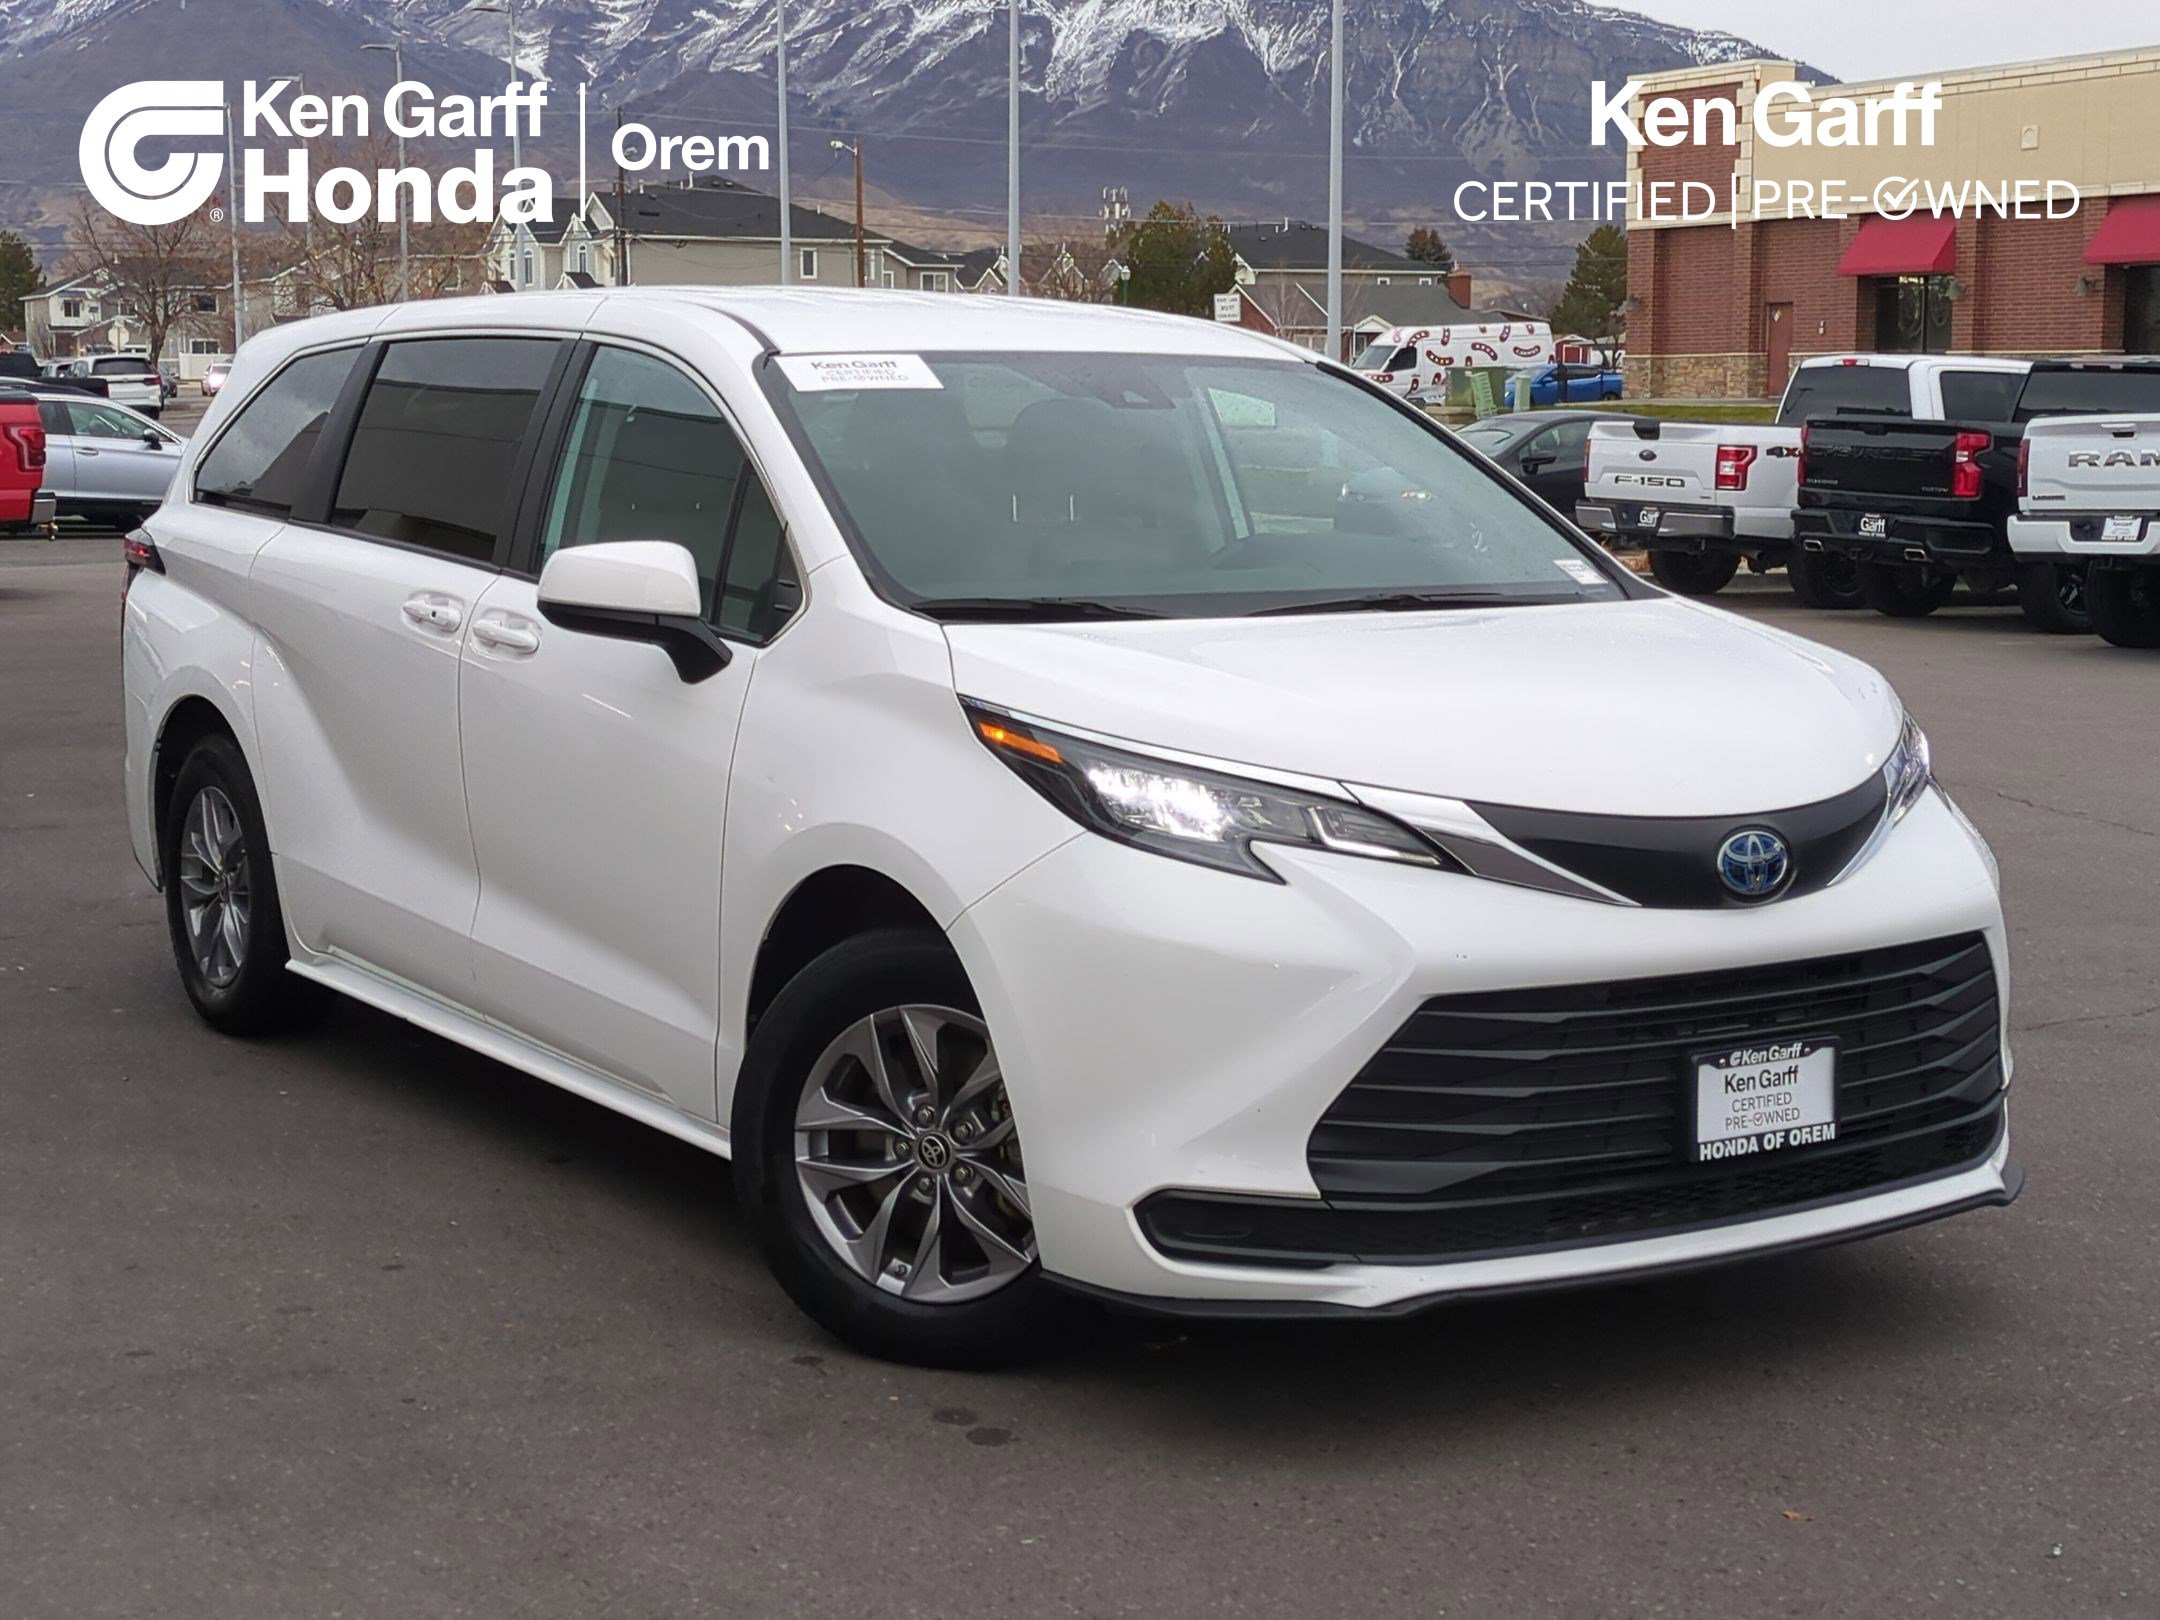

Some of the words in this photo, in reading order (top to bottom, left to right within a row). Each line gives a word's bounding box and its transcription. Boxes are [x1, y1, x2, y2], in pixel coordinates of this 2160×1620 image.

[1614, 475, 1685, 488] F-150
[1741, 1049, 1767, 1066] Ken
[1768, 1042, 1803, 1061] Garff
[1724, 1073, 1757, 1094] Ken
[1759, 1065, 1799, 1089] Garff
[1731, 1092, 1793, 1113] CERTIFIED
[1725, 1107, 1801, 1131] PRE-OWNED
[1699, 1136, 1760, 1162] HONDA
[1762, 1131, 1786, 1151] OF
[1788, 1123, 1836, 1146] OREM
